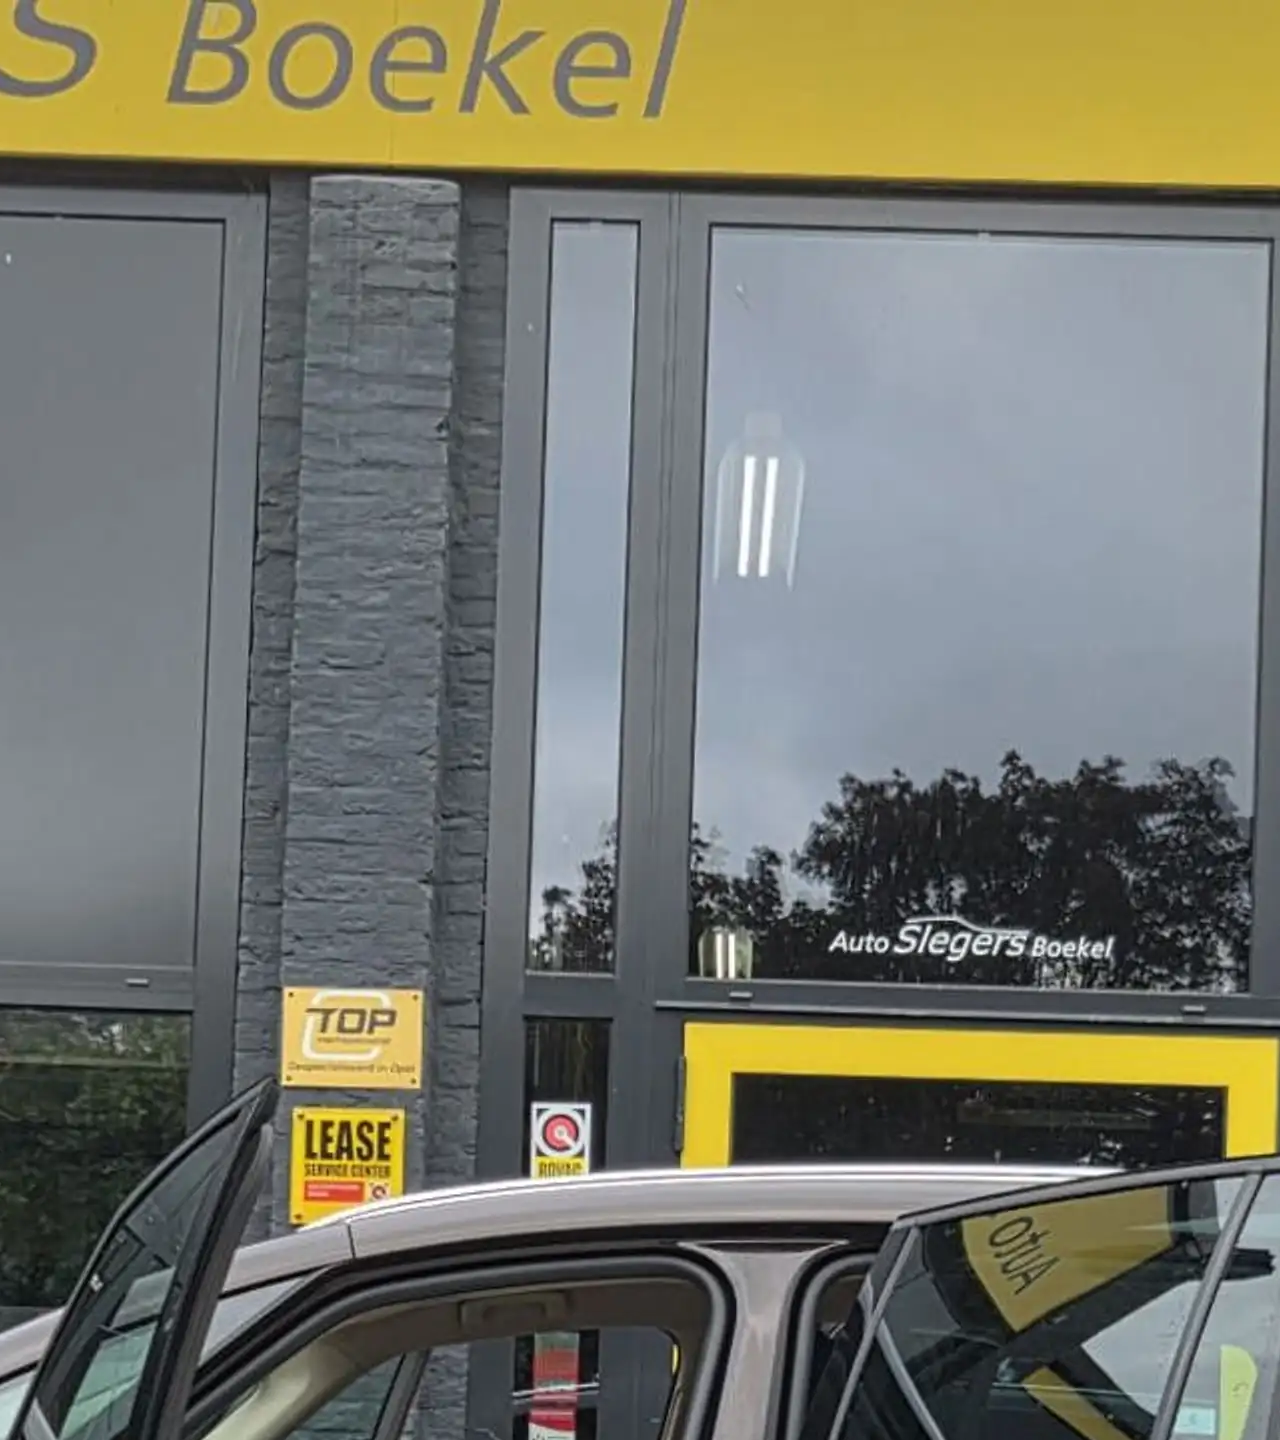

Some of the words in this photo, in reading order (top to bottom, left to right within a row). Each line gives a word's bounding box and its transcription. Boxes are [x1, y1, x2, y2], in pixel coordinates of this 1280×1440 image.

[166, 0, 687, 119] Boekel
[828, 930, 890, 953] Auto
[893, 923, 1029, 962] Slegers
[1031, 935, 1116, 959] Boekel
[305, 1007, 397, 1034] TOP
[304, 1119, 391, 1161] LEASE
